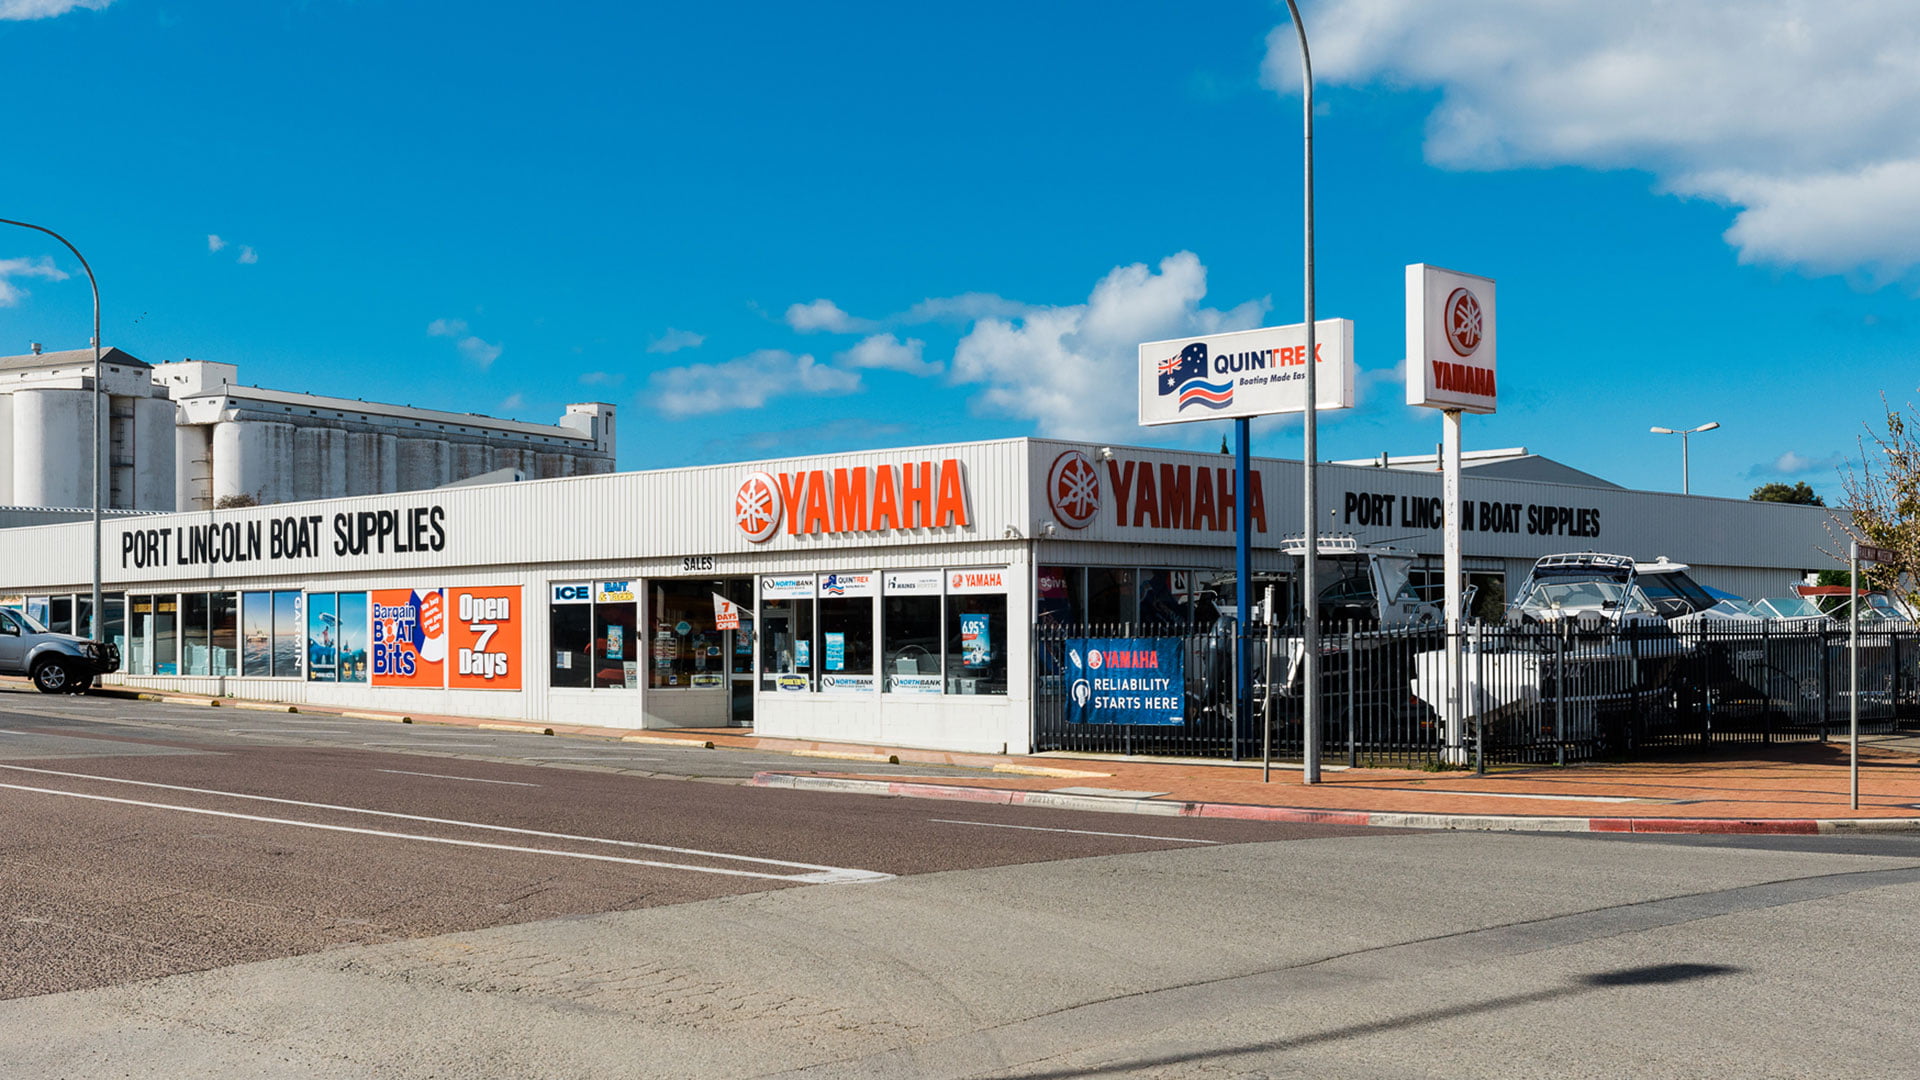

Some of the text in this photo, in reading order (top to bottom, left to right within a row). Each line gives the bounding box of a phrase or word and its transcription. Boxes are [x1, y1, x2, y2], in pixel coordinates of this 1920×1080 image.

[1239, 372, 1305, 387] Boating Made Eas
[1432, 360, 1496, 397] YAMAHA
[778, 459, 968, 535] YAMAHA
[1108, 459, 1267, 533] YAMAHA
[1345, 492, 1600, 537] PORT LINCN BOAT SUPPLIES
[122, 505, 445, 568] PORT LINCOLN BOAT SUPPLIES
[683, 556, 713, 571] SALES
[604, 581, 629, 592] BAIT
[775, 580, 813, 588] NORTHBANK
[839, 576, 869, 584] QUINTREX
[965, 573, 1002, 587] YAMAHA
[555, 586, 589, 600] ICE
[374, 603, 415, 622] Bargain
[459, 594, 510, 623] Open
[721, 601, 730, 613] 7
[717, 613, 737, 621] DAYS
[294, 596, 302, 667] GARMIN
[374, 619, 415, 642] BOAT
[717, 622, 738, 630] OPEN
[469, 625, 498, 652] 7
[374, 643, 415, 675] Bits
[459, 647, 508, 679] Days
[1102, 650, 1159, 669] YAMAHA
[835, 678, 873, 686] NORTHBANK
[1094, 678, 1170, 691] RELIABILITY
[1094, 697, 1178, 709] STARTS HERE
